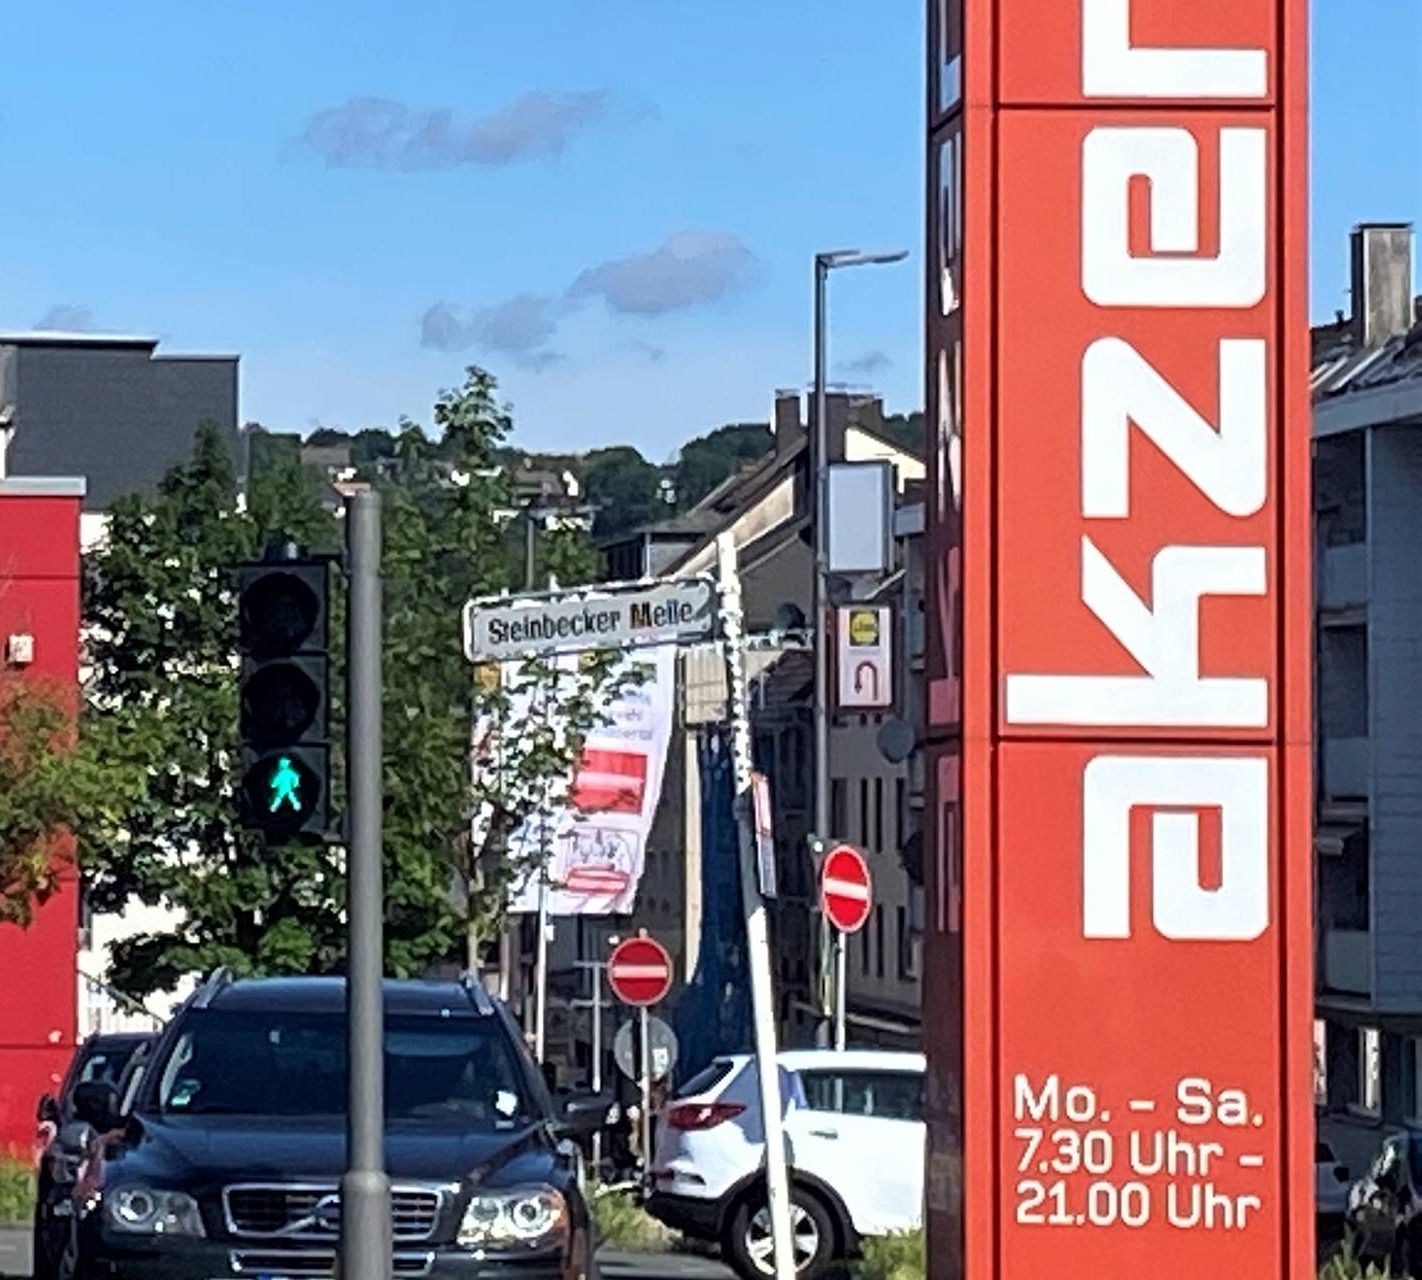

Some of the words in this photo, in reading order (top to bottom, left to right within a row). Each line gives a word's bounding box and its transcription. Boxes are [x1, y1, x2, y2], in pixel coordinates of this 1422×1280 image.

[487, 608, 621, 645] Steinbecker
[1014, 1074, 1110, 1122] Mo.
[1129, 1100, 1155, 1110] -
[1177, 1078, 1263, 1126] Sa.
[1014, 1128, 1113, 1173] 7.30
[1130, 1130, 1224, 1176] Uhr
[1239, 1155, 1263, 1166] -
[1016, 1180, 1150, 1226] 21.00
[1168, 1183, 1261, 1229] Uhr
